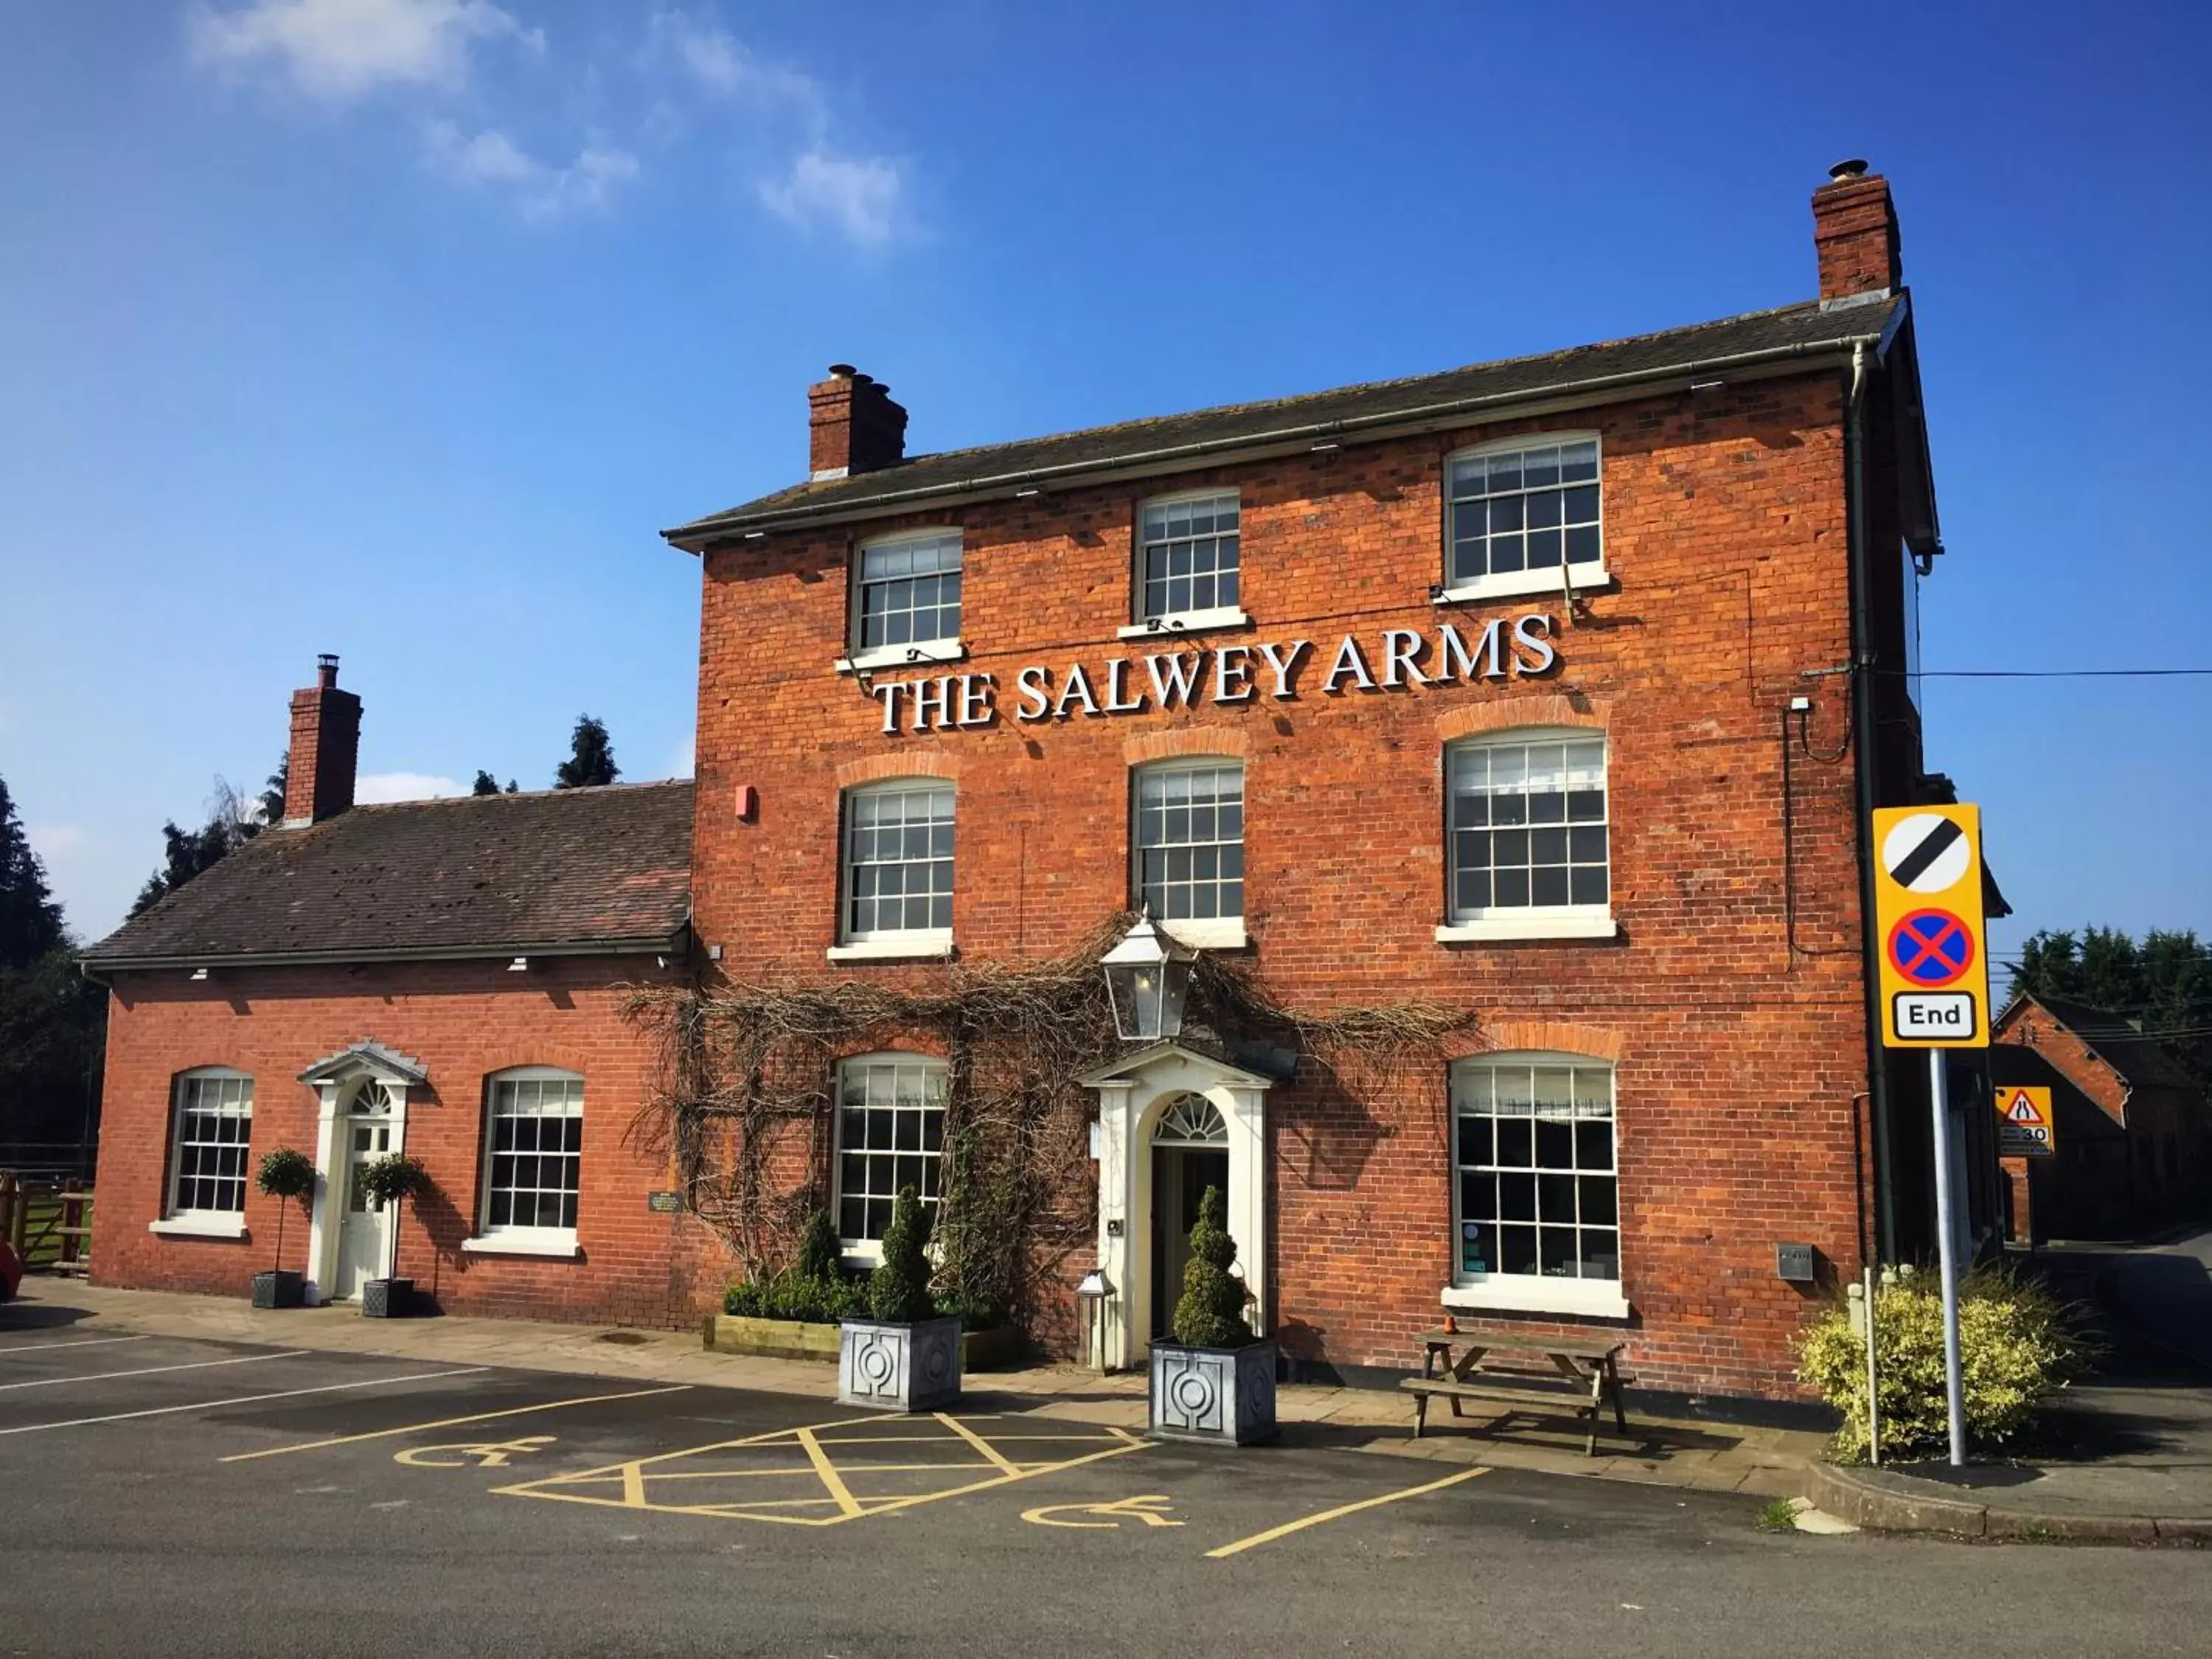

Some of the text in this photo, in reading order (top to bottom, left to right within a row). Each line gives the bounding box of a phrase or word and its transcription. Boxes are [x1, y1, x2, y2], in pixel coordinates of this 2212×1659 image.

[873, 613, 1554, 732] THE SALWEY ARMS
[1909, 1004, 1961, 1024] End
[2023, 1128, 2046, 1141] 30
